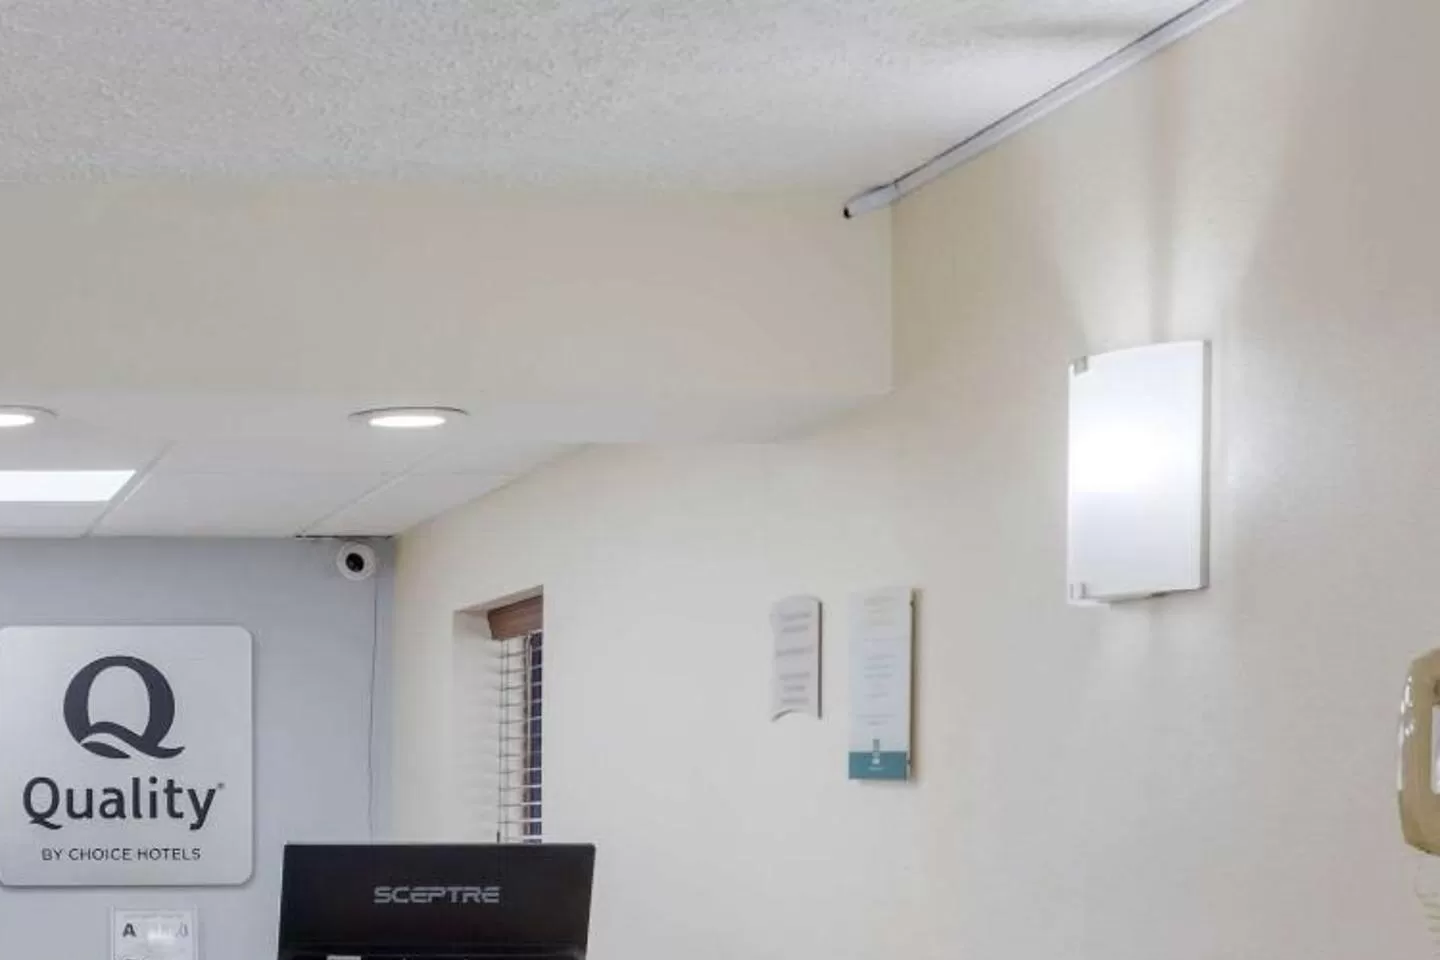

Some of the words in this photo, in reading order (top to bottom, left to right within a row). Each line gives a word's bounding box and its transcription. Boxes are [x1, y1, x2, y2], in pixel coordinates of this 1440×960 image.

[63, 655, 185, 759] Q
[22, 776, 217, 831] Quality
[42, 848, 64, 861] BY
[68, 848, 133, 861] CHOICE
[137, 848, 201, 861] HOTELS
[373, 886, 501, 903] SCEPTRE
